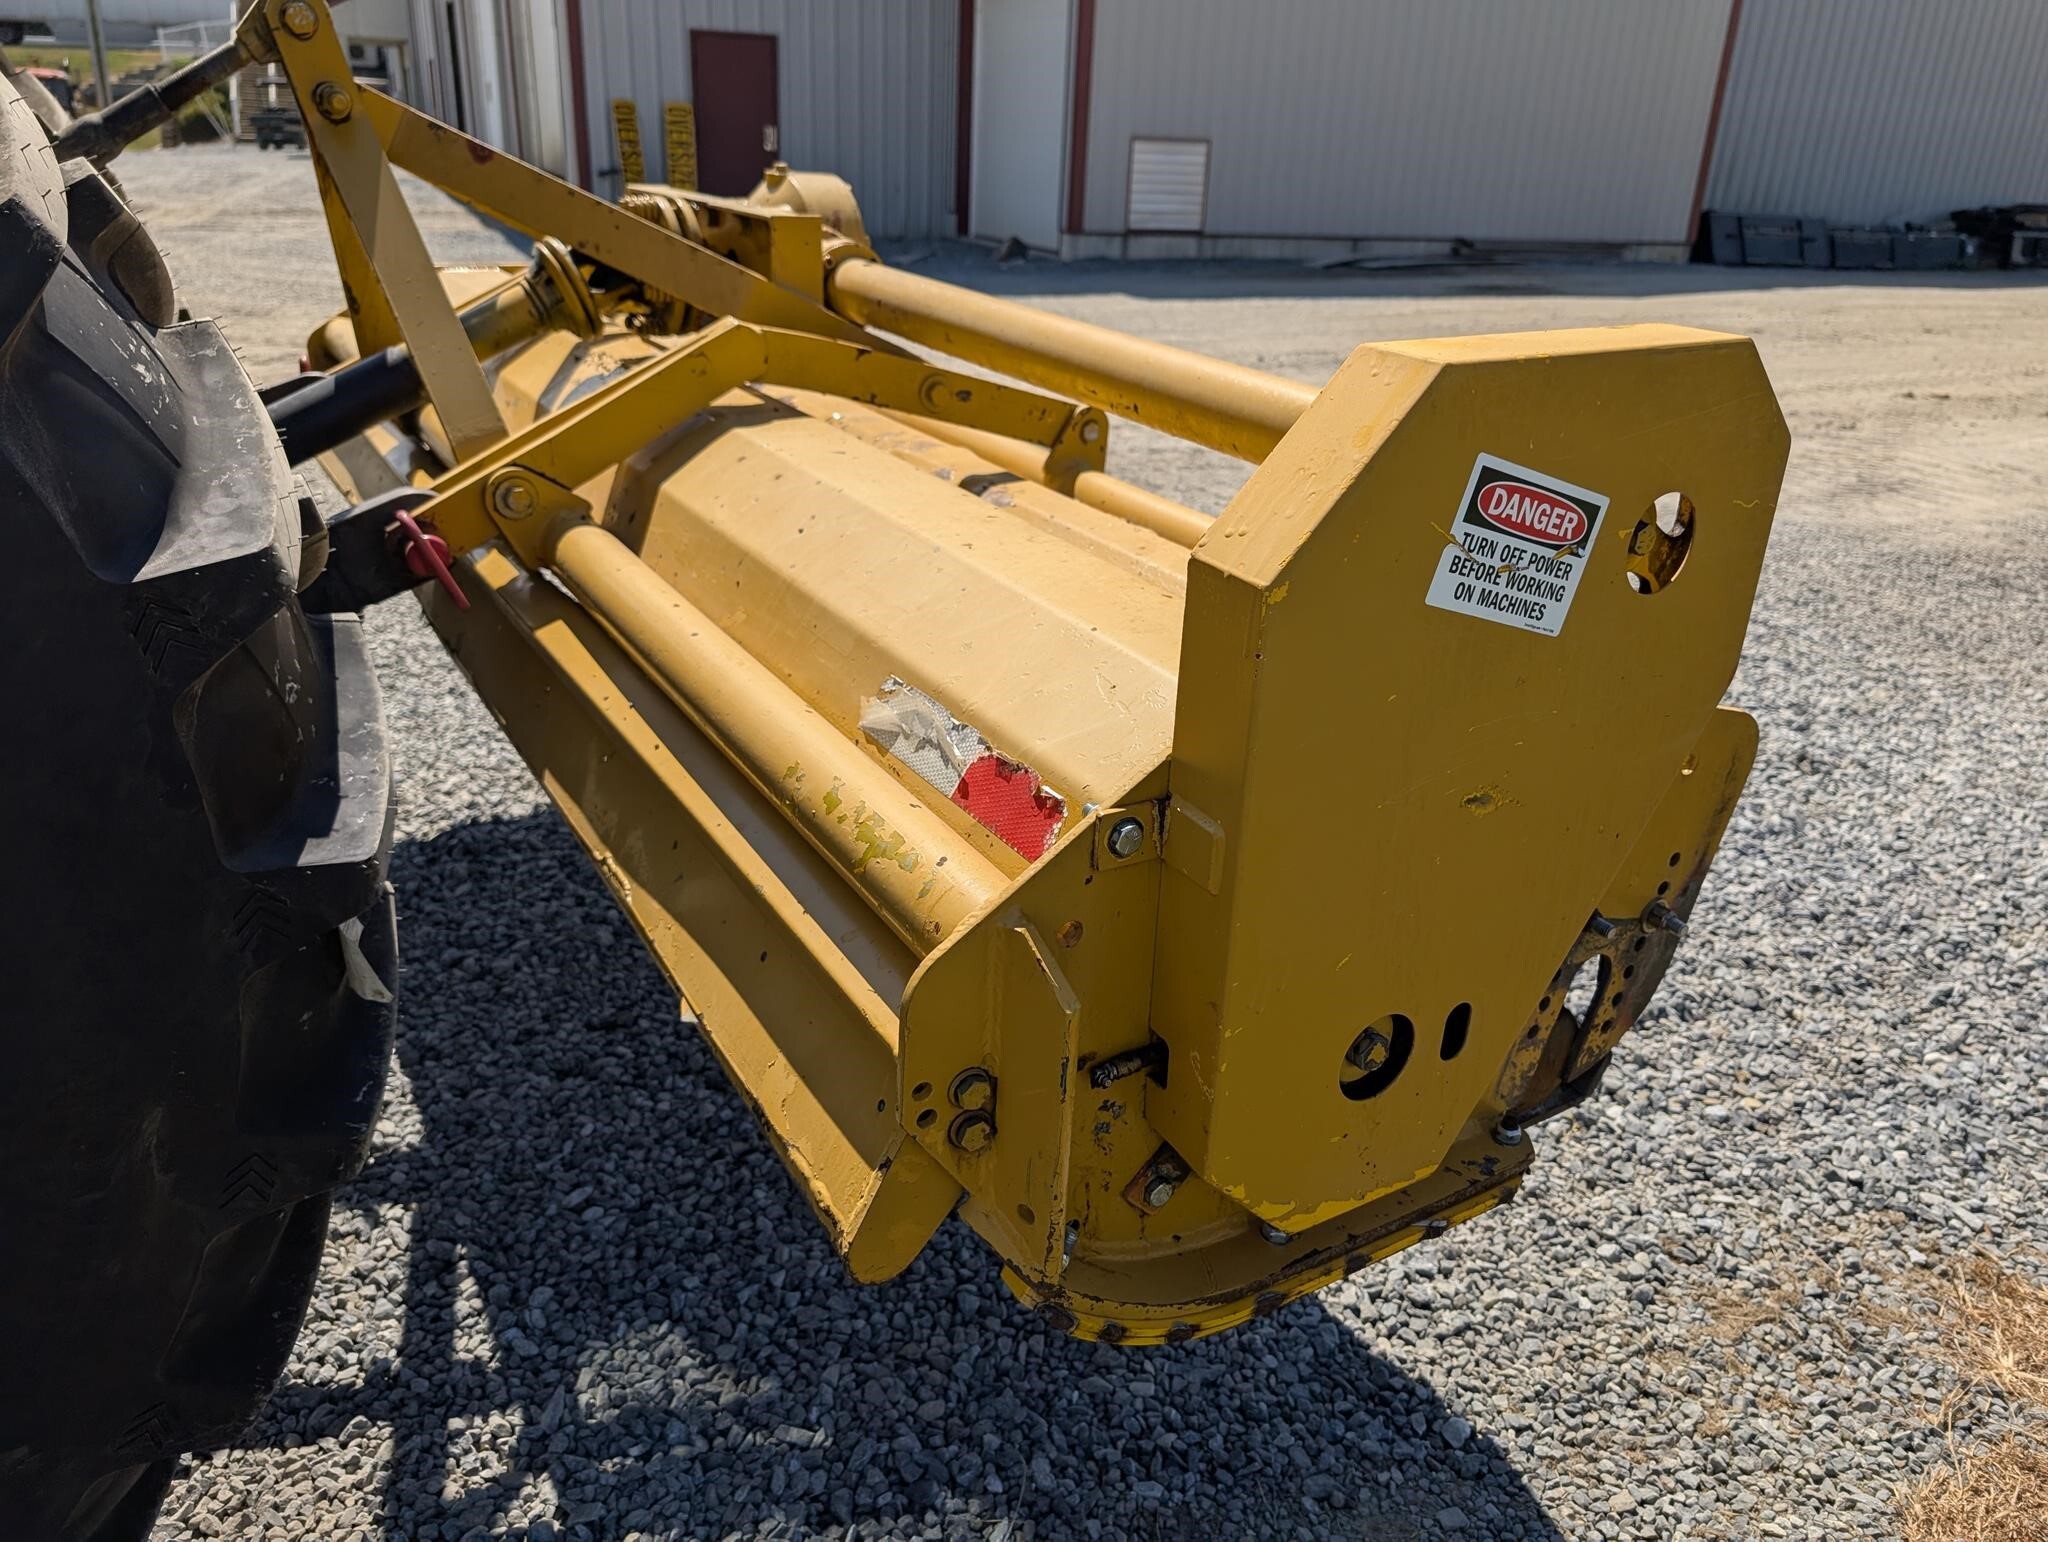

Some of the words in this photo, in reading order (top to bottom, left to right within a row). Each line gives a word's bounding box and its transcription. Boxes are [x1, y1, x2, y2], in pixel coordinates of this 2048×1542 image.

[1487, 487, 1579, 540] DANGER
[1448, 555, 1502, 586] BEFORE
[1504, 570, 1566, 603] WORKING
[1462, 531, 1498, 560] TURN
[1500, 544, 1528, 566] OFF
[1528, 553, 1573, 581] POWER
[1453, 581, 1476, 603] ON
[1476, 587, 1547, 622] MACHINES
